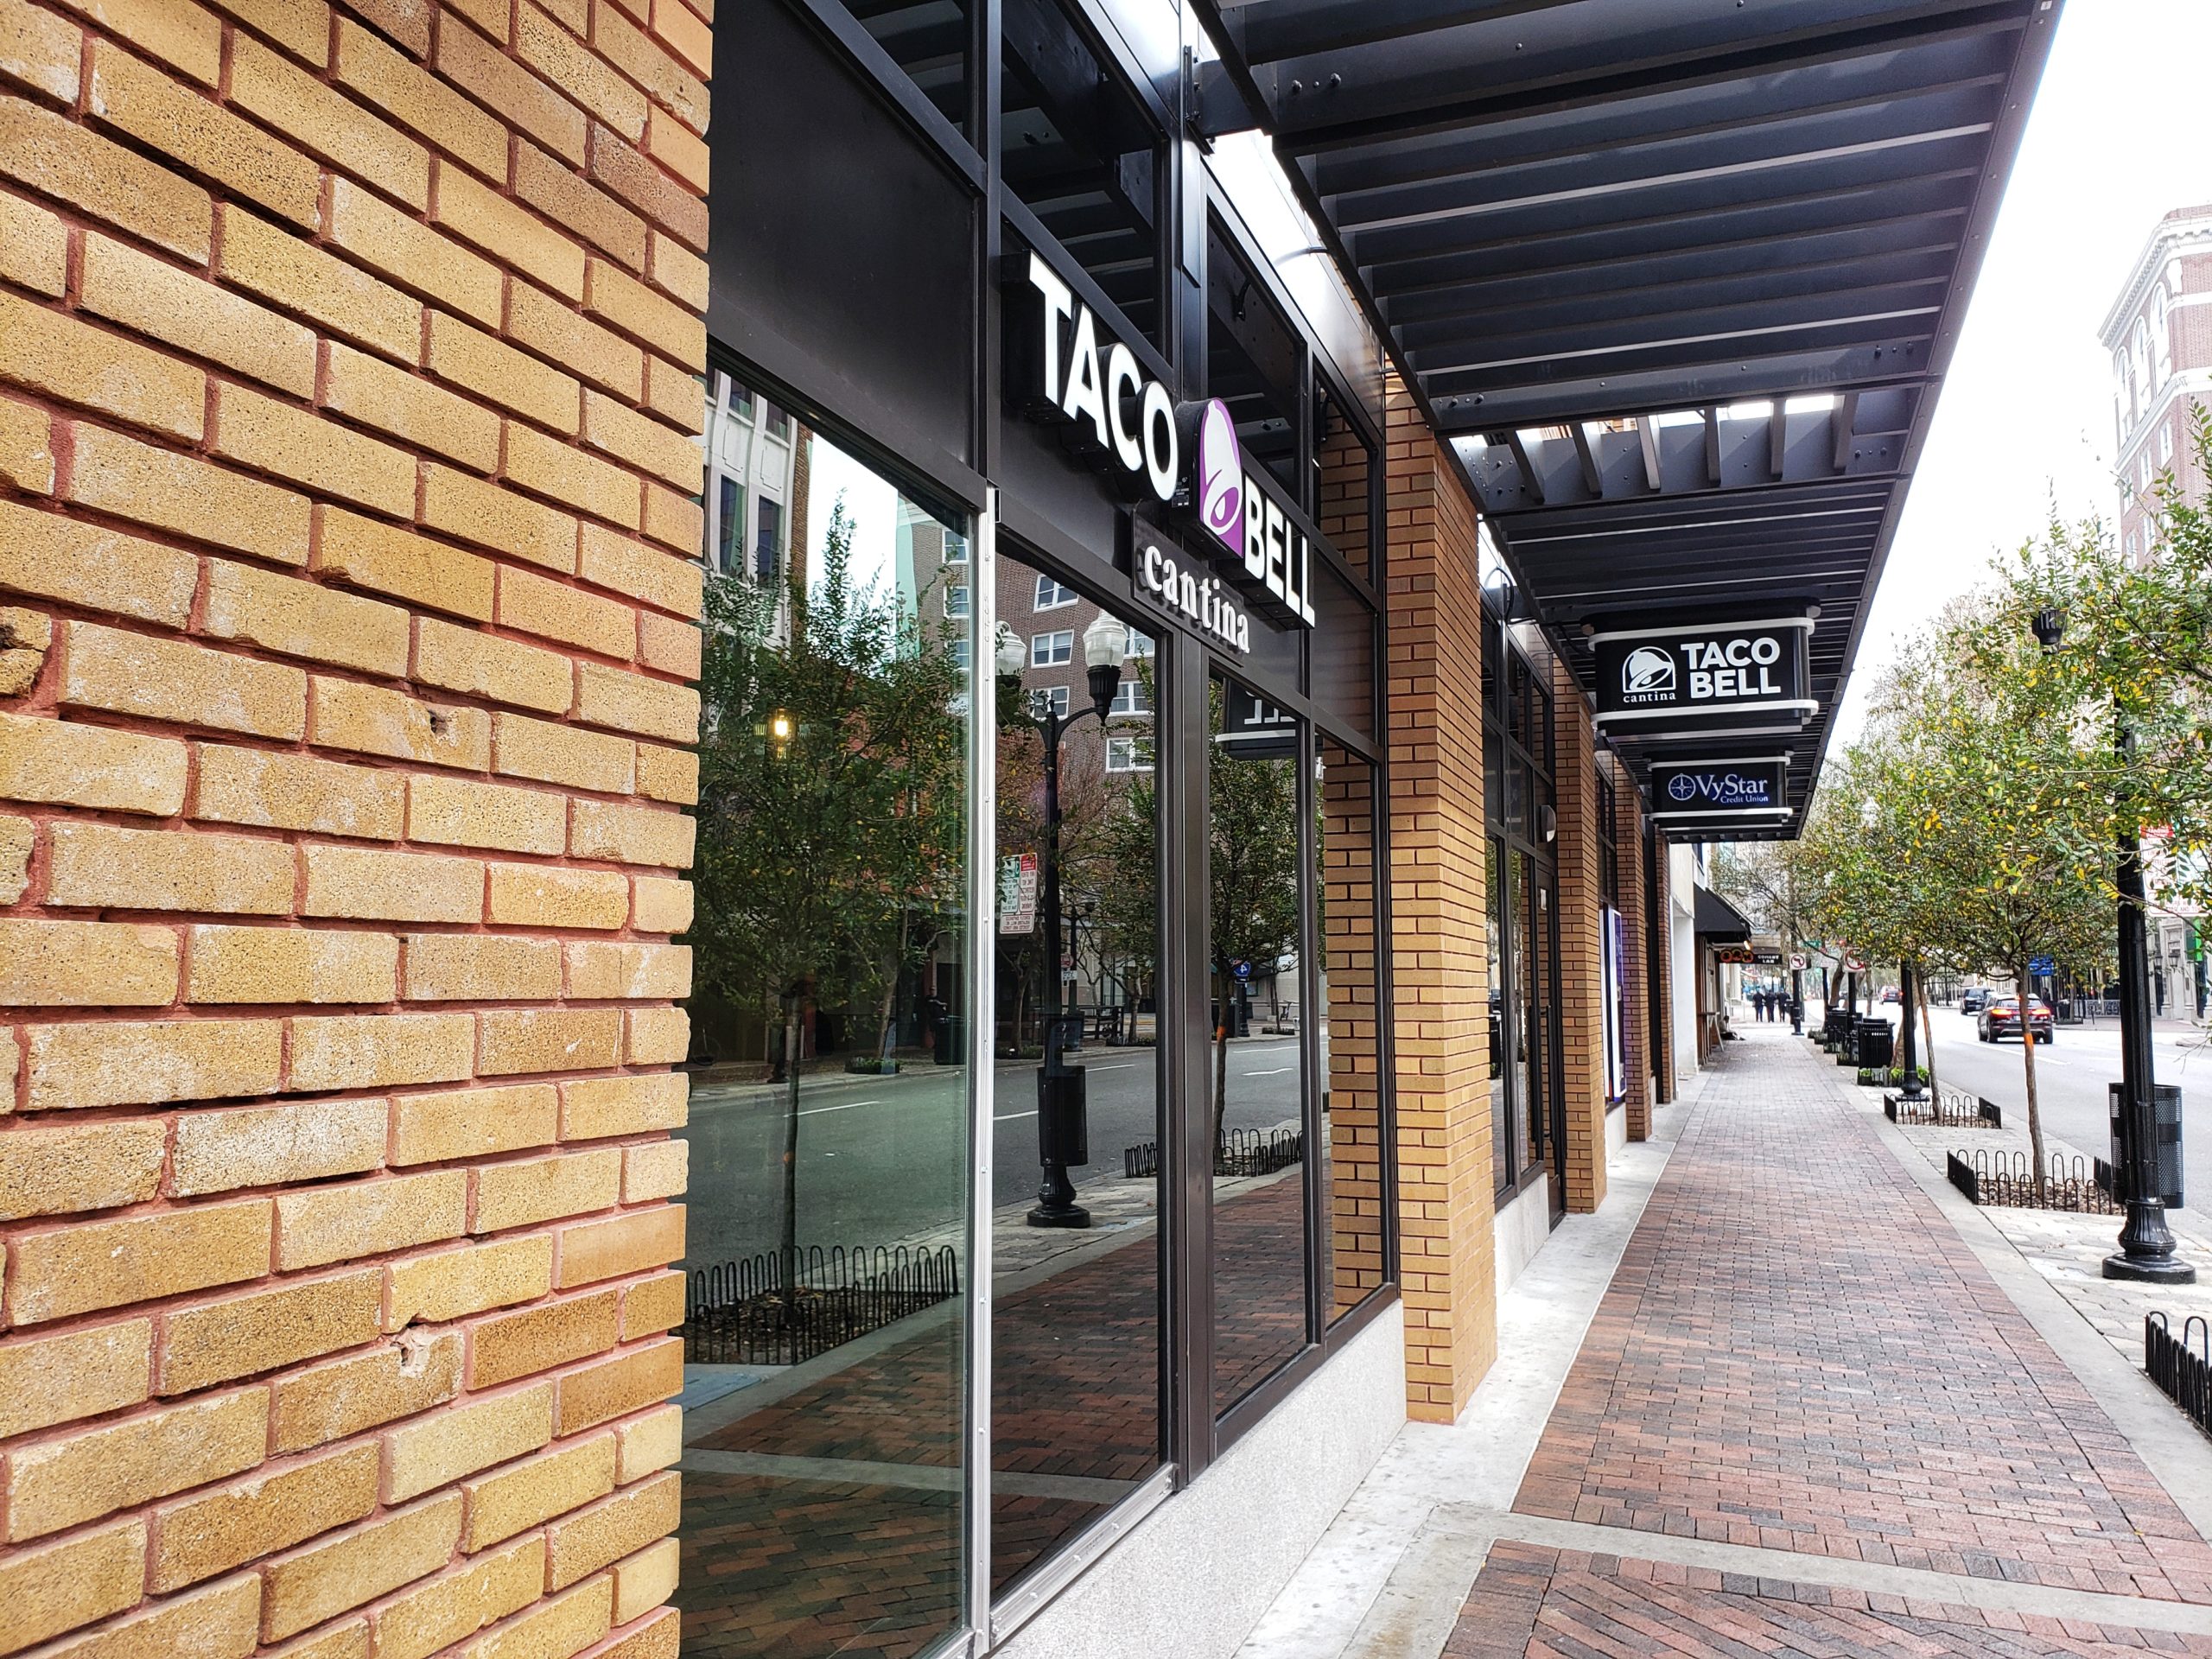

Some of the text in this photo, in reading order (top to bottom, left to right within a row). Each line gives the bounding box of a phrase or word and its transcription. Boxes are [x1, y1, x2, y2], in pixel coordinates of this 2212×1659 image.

[1029, 251, 1315, 630] TACO BELL
[1144, 545, 1251, 655] cantina
[1680, 637, 1781, 671] TACO
[1623, 691, 1676, 703] cantina
[1690, 666, 1782, 699] BELL
[1694, 773, 1769, 801] VyStar
